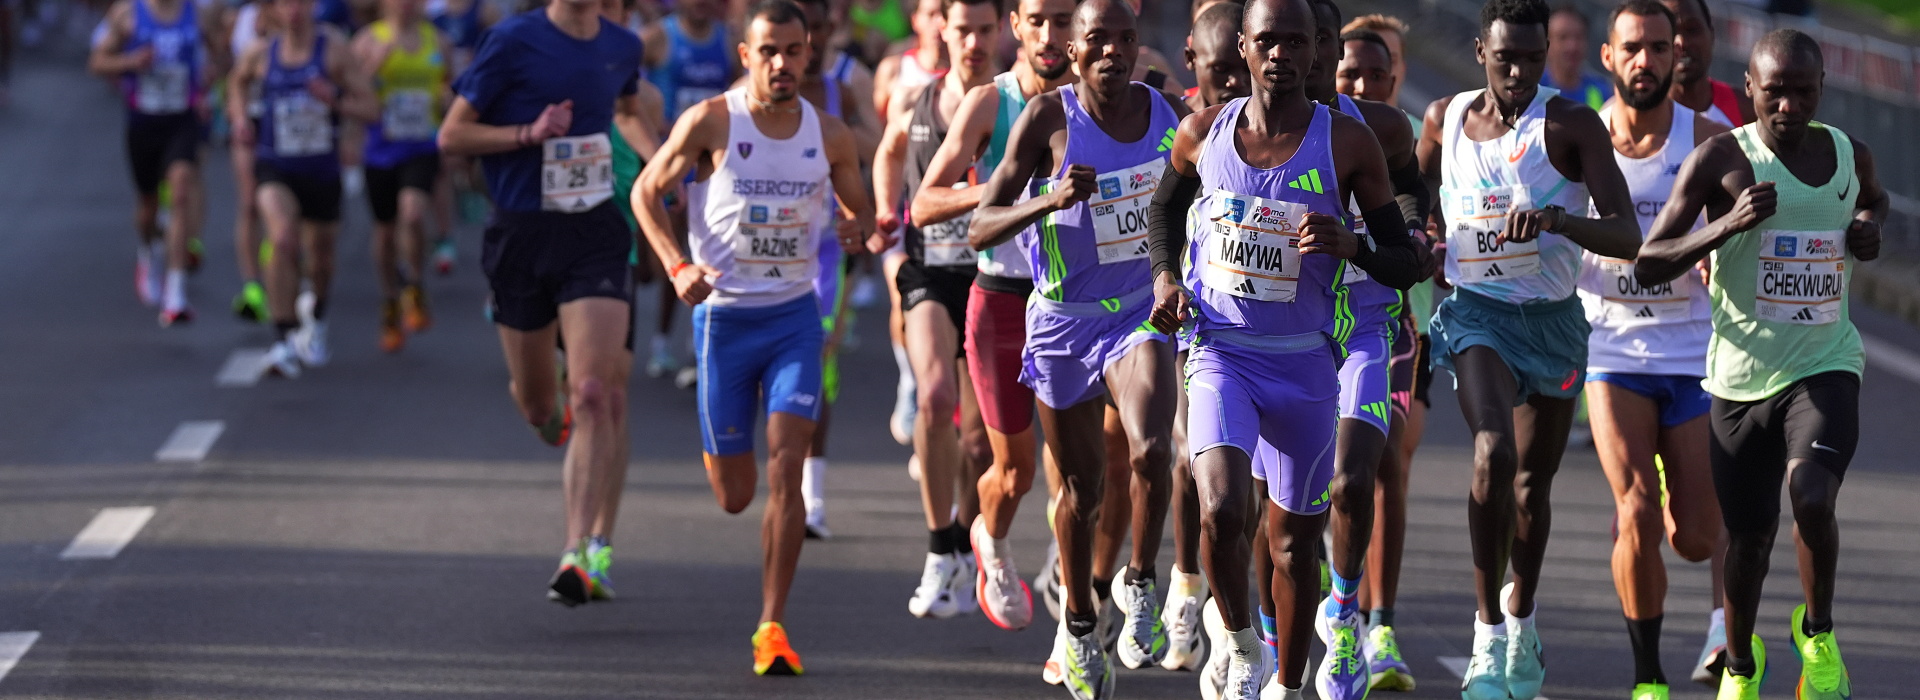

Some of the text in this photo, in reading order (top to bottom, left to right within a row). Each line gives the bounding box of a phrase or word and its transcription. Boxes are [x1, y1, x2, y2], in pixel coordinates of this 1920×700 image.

[568, 165, 588, 188] 25
[1133, 198, 1139, 207] 8
[932, 219, 971, 240] ESPO
[1116, 207, 1149, 235] LOK
[1249, 231, 1258, 242] 13
[751, 237, 798, 257] RAZINE
[1221, 237, 1283, 273] MAYWA
[1805, 263, 1811, 272] 4
